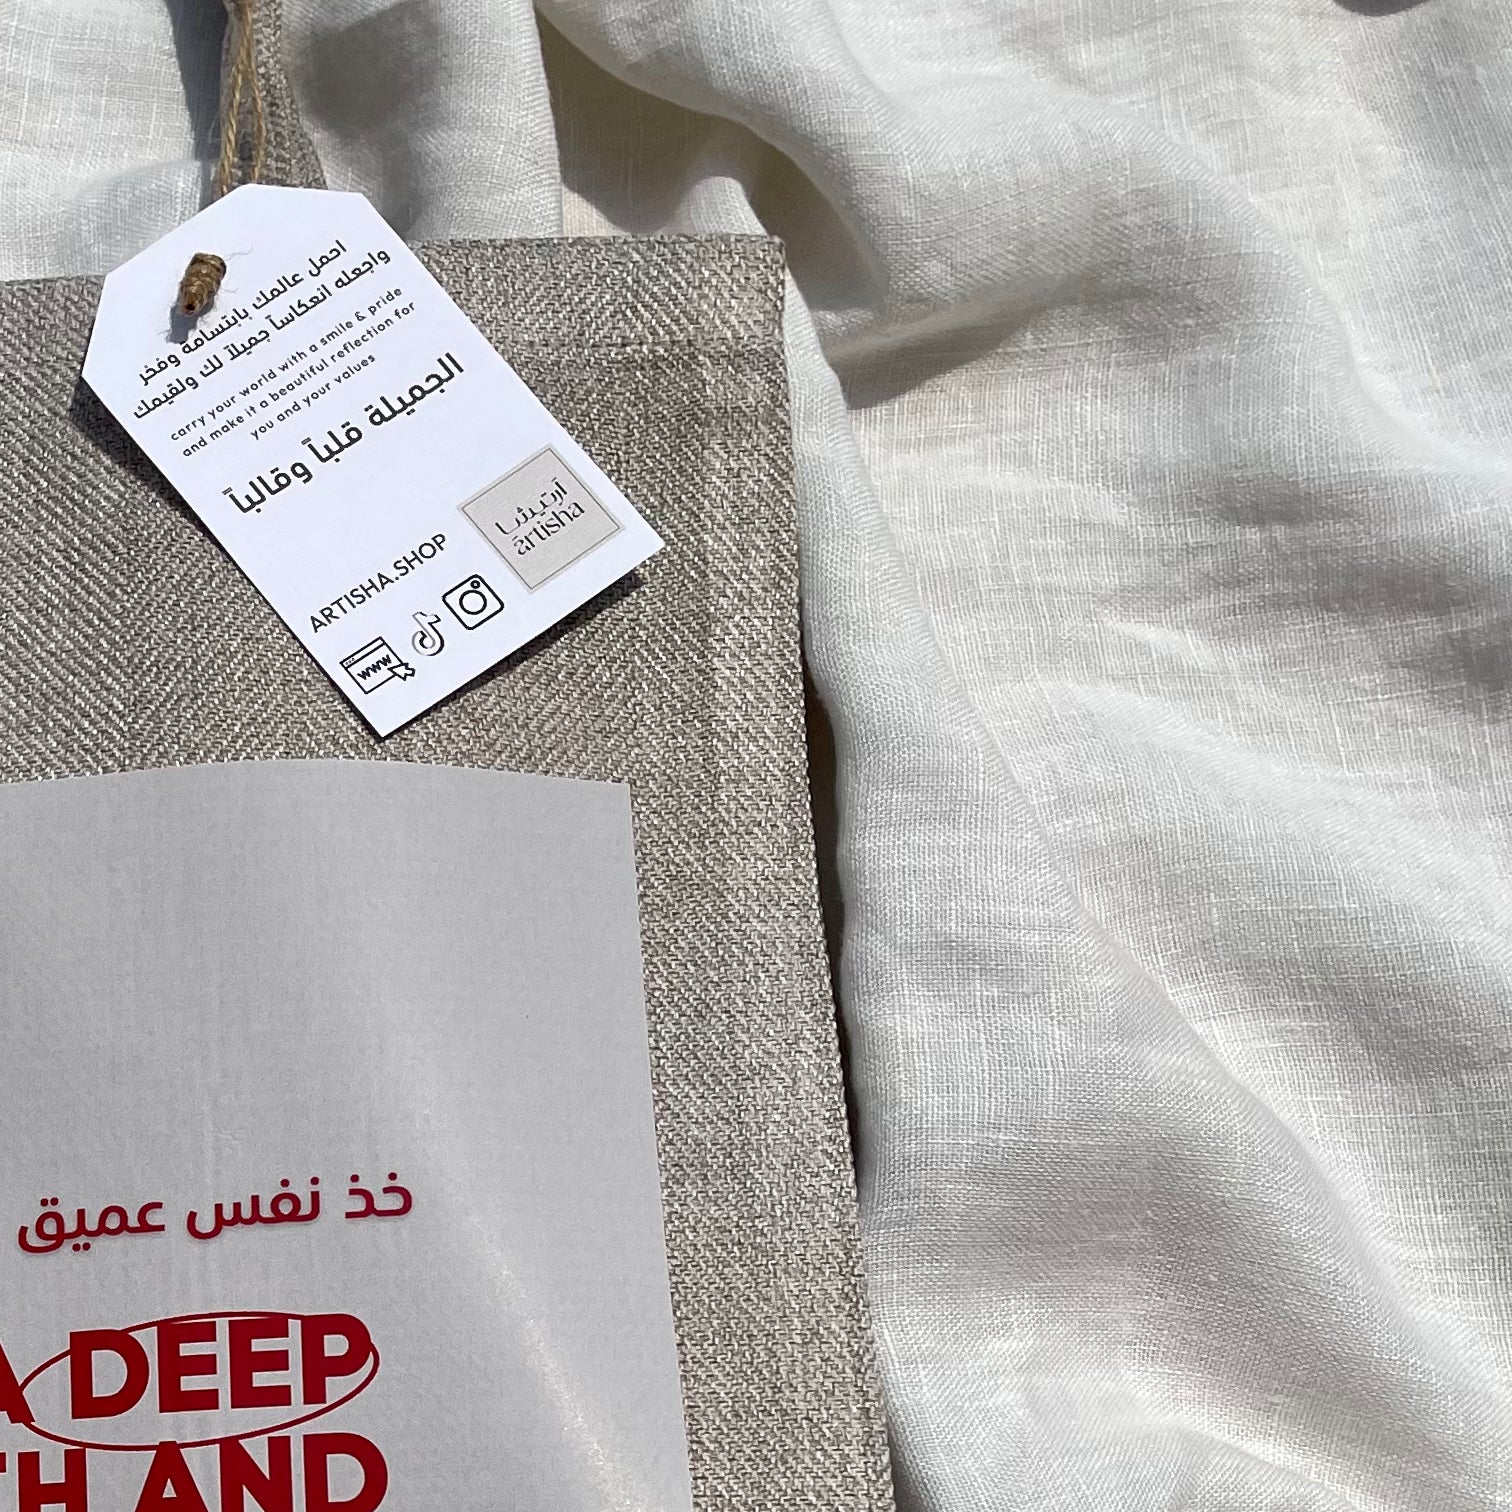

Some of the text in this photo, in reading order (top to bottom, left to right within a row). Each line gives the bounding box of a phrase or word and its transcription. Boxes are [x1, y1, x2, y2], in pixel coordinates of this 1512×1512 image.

[334, 250, 391, 289] واجعله
[138, 238, 347, 387] احمل عالمك بابتسامة وفخر
[132, 376, 199, 419] ولقيمك
[170, 288, 402, 441] carry your world with a smile & pride
[182, 301, 415, 457] and make it a beautiful reflection for
[198, 353, 224, 378] لك
[250, 354, 376, 441] you and your values
[363, 351, 465, 426] الجميلة
[309, 533, 446, 634] ARTISHA.SHOP
[18, 1197, 165, 1254] عميق
[186, 1178, 320, 1240] نفس
[345, 1172, 413, 1219] خذ
[69, 1313, 373, 1420] DEEP
